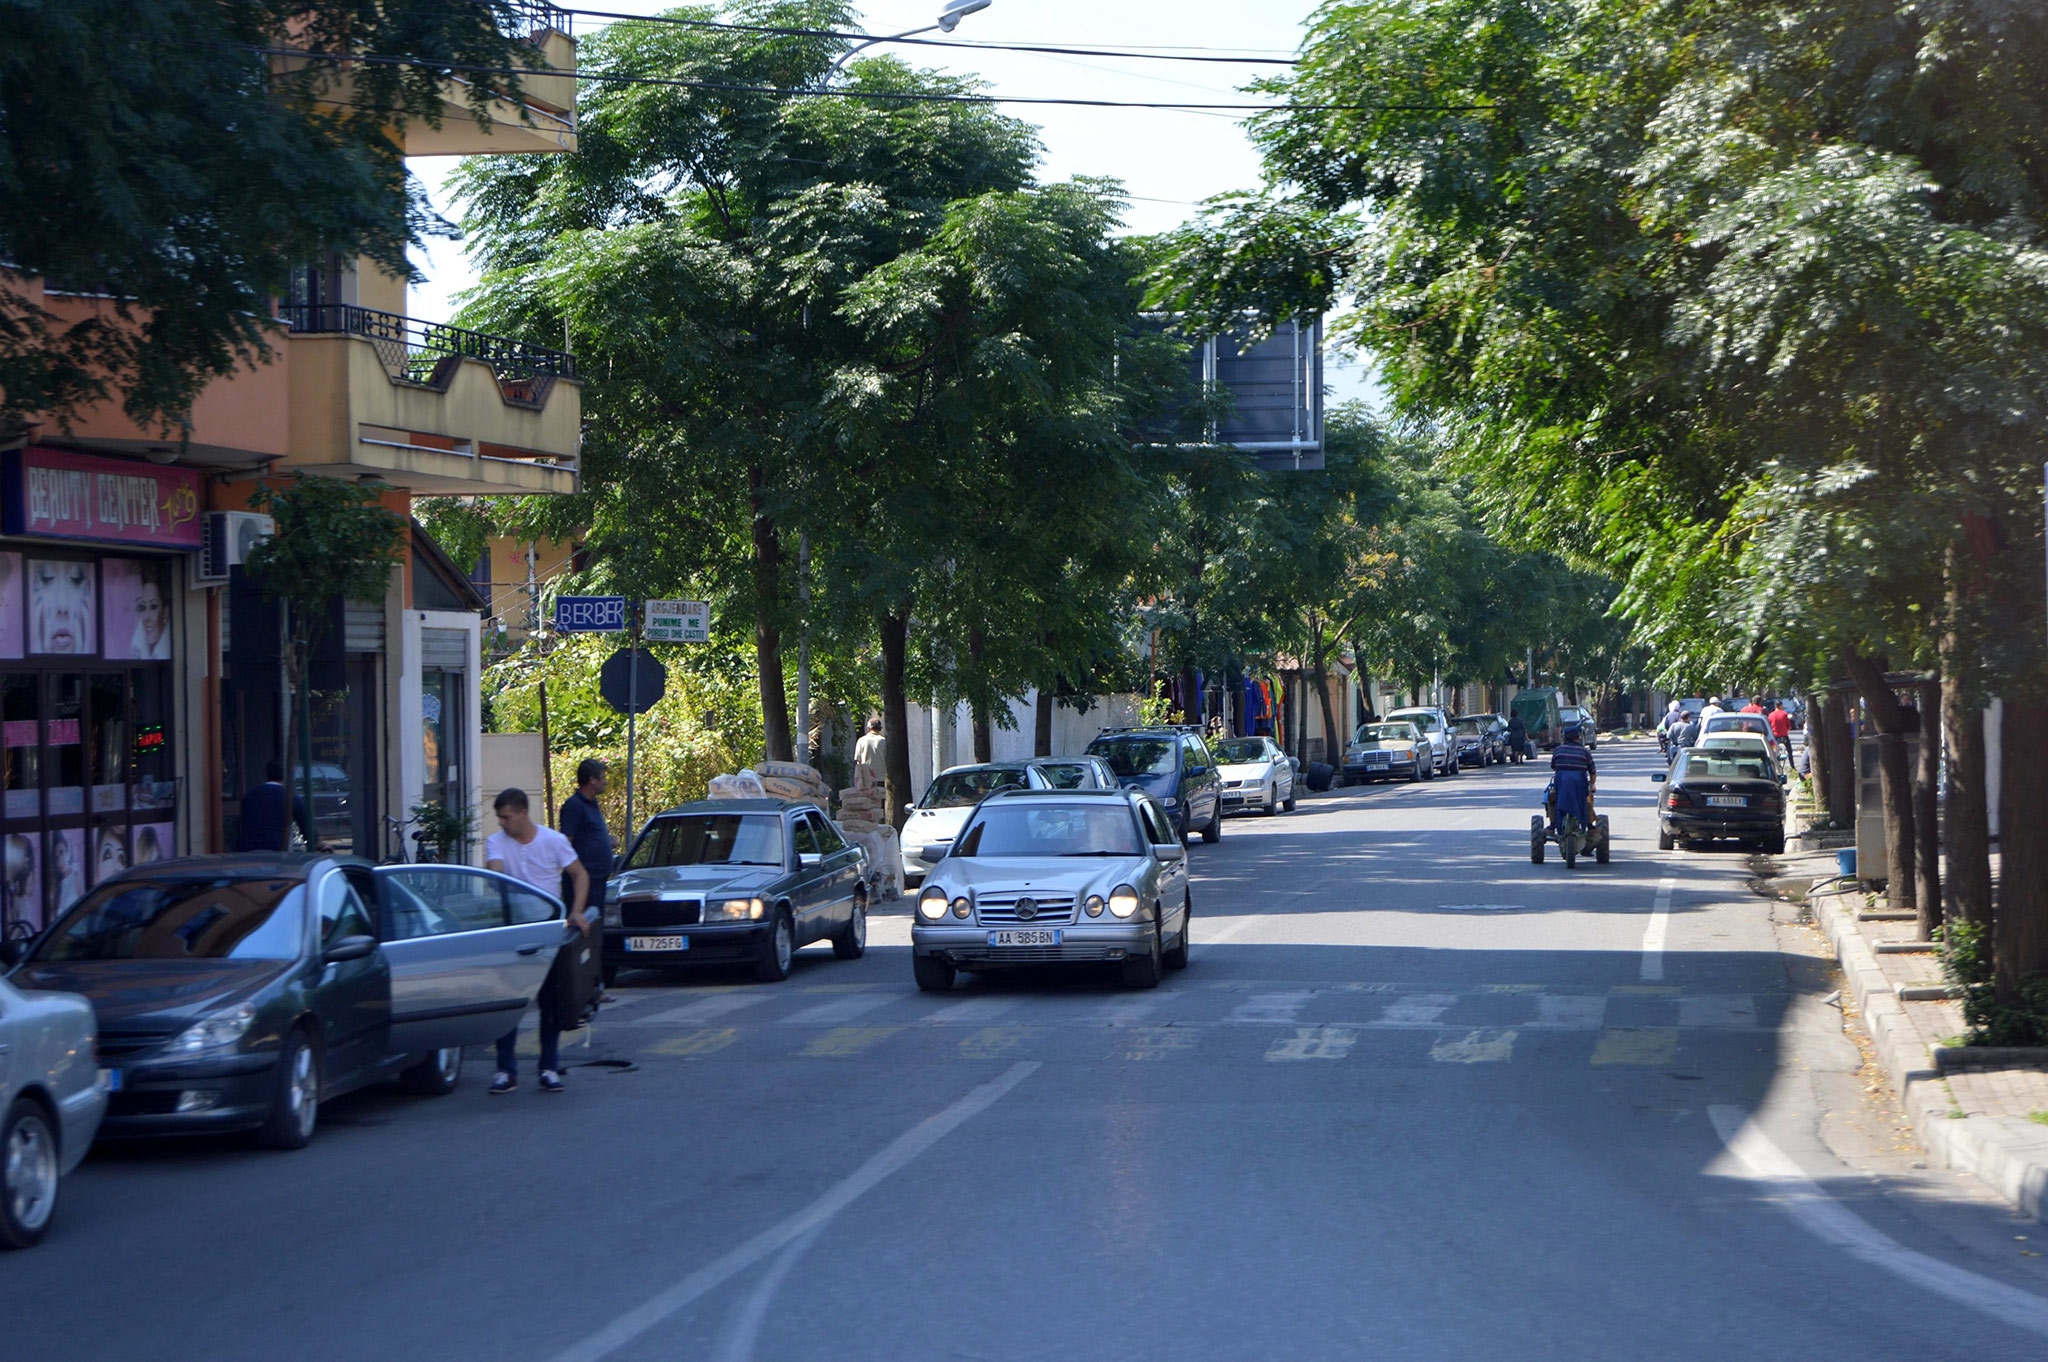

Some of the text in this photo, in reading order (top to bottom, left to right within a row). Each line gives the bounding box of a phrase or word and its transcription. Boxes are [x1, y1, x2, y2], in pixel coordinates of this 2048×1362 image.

[560, 600, 624, 625] BERBER
[653, 617, 700, 628] PUNIME ME
[773, 782, 793, 794] TITAN
[633, 939, 645, 949] AA
[999, 932, 1011, 944] AA
